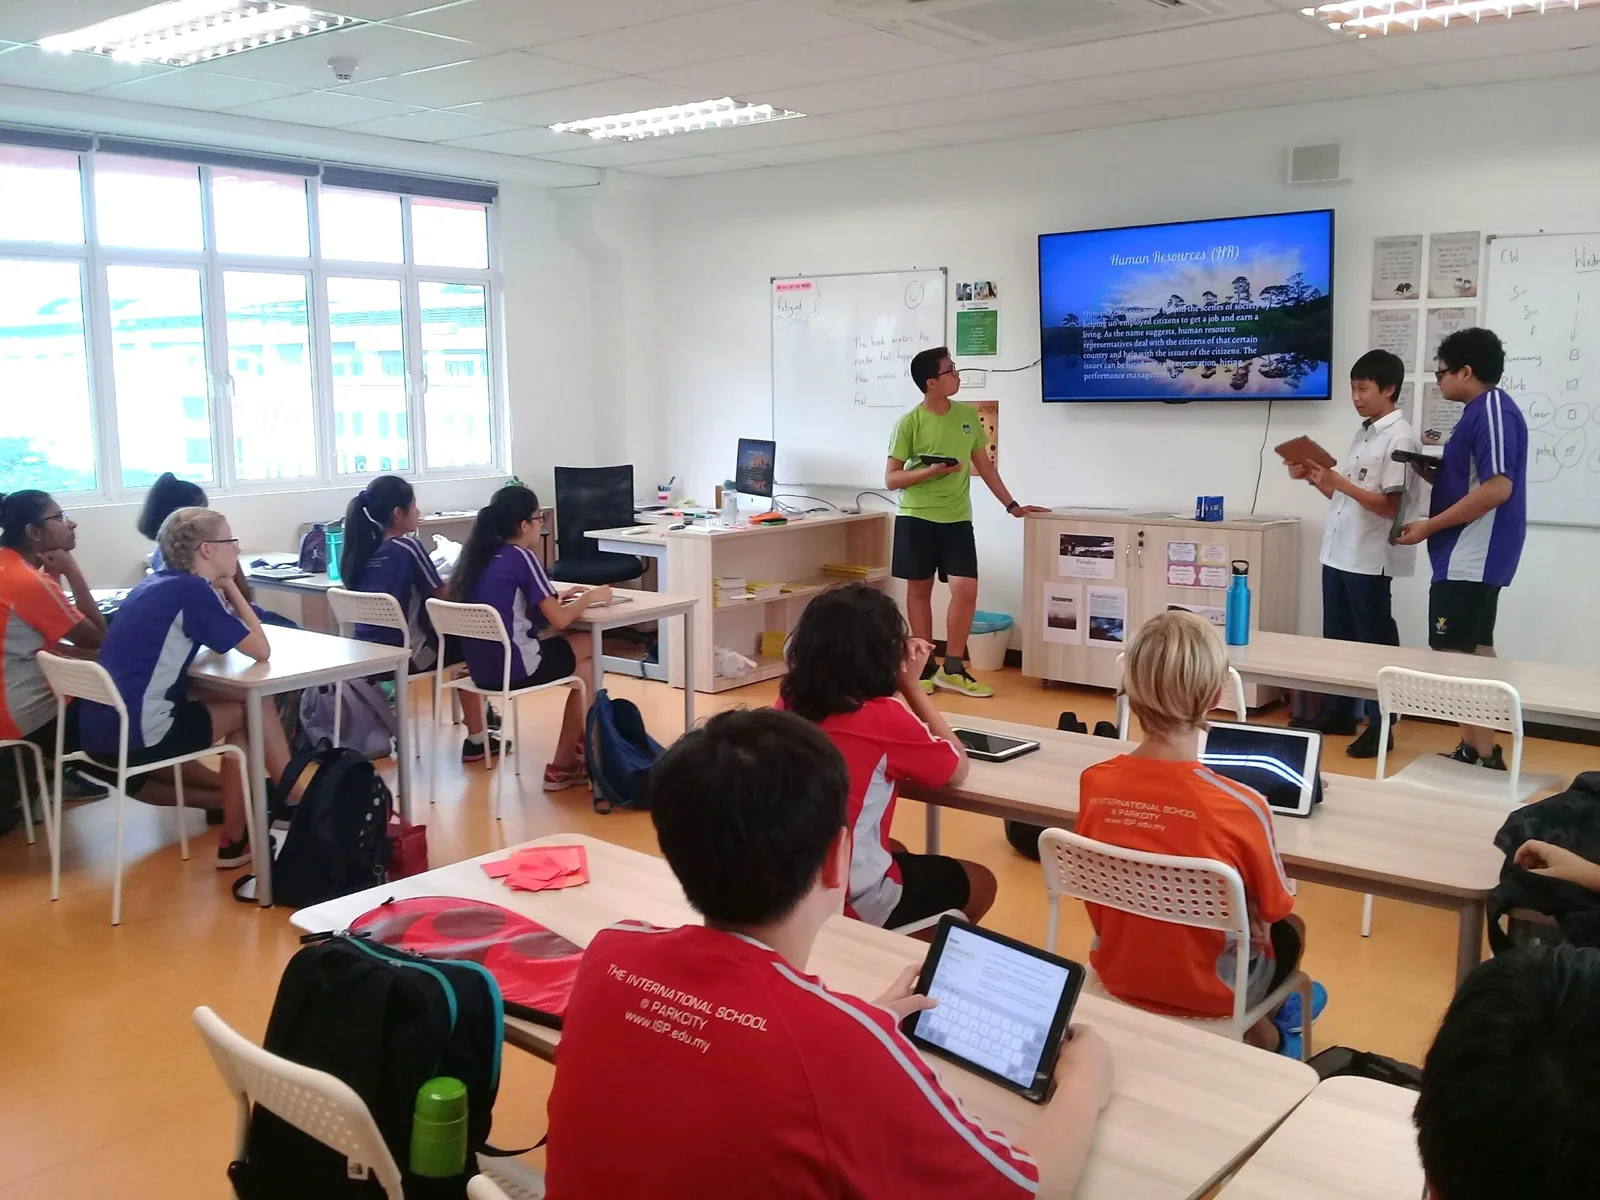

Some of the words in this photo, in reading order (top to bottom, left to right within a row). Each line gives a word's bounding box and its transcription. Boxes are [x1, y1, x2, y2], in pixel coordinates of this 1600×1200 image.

[1110, 253, 1149, 267] Human
[1152, 250, 1206, 264] Resources
[1211, 244, 1240, 262] (HR)
[1200, 303, 1224, 312] scenes
[1225, 301, 1233, 311] of
[1234, 301, 1259, 312] society
[1083, 319, 1107, 329] helping
[1153, 315, 1180, 325] citizens
[1181, 315, 1189, 324] to
[1189, 316, 1201, 325] get
[1208, 313, 1220, 324] job
[1220, 313, 1235, 322] and
[1082, 330, 1103, 340] living.
[1104, 330, 1112, 338] As
[1113, 329, 1125, 337] the
[1145, 328, 1177, 338] suggests,
[1178, 326, 1203, 335] human
[1204, 326, 1236, 334] resource
[854, 336, 868, 348] The
[1083, 340, 1132, 350] representatives
[1133, 338, 1148, 347] deal
[1148, 337, 1165, 346] with
[1165, 337, 1177, 346] the
[1178, 336, 1205, 345] citizens
[1206, 335, 1216, 344] of
[1216, 335, 1230, 344] that
[1231, 334, 1258, 343] certain
[1083, 352, 1108, 362] country
[1109, 350, 1122, 359] and
[1123, 349, 1138, 360] help
[1138, 348, 1154, 358] with
[1155, 348, 1166, 357] the
[1167, 348, 1189, 357] issues
[1189, 347, 1198, 356] of
[1198, 347, 1210, 356] the
[1211, 346, 1242, 355] citizens.
[1243, 346, 1257, 354] The
[1083, 361, 1103, 370] issues
[1117, 360, 1125, 369] be
[1083, 371, 1125, 381] performance
[1501, 376, 1526, 391] Blurb
[1098, 797, 1161, 813] INTERNATIONAL
[1162, 805, 1198, 820] SCHOOL
[1118, 808, 1160, 821] PARKCITY
[606, 963, 628, 982] THE
[626, 973, 713, 1015] INTERNATIONAL
[715, 1006, 768, 1032] SCHOOL
[650, 1001, 709, 1031] PARKCITY
